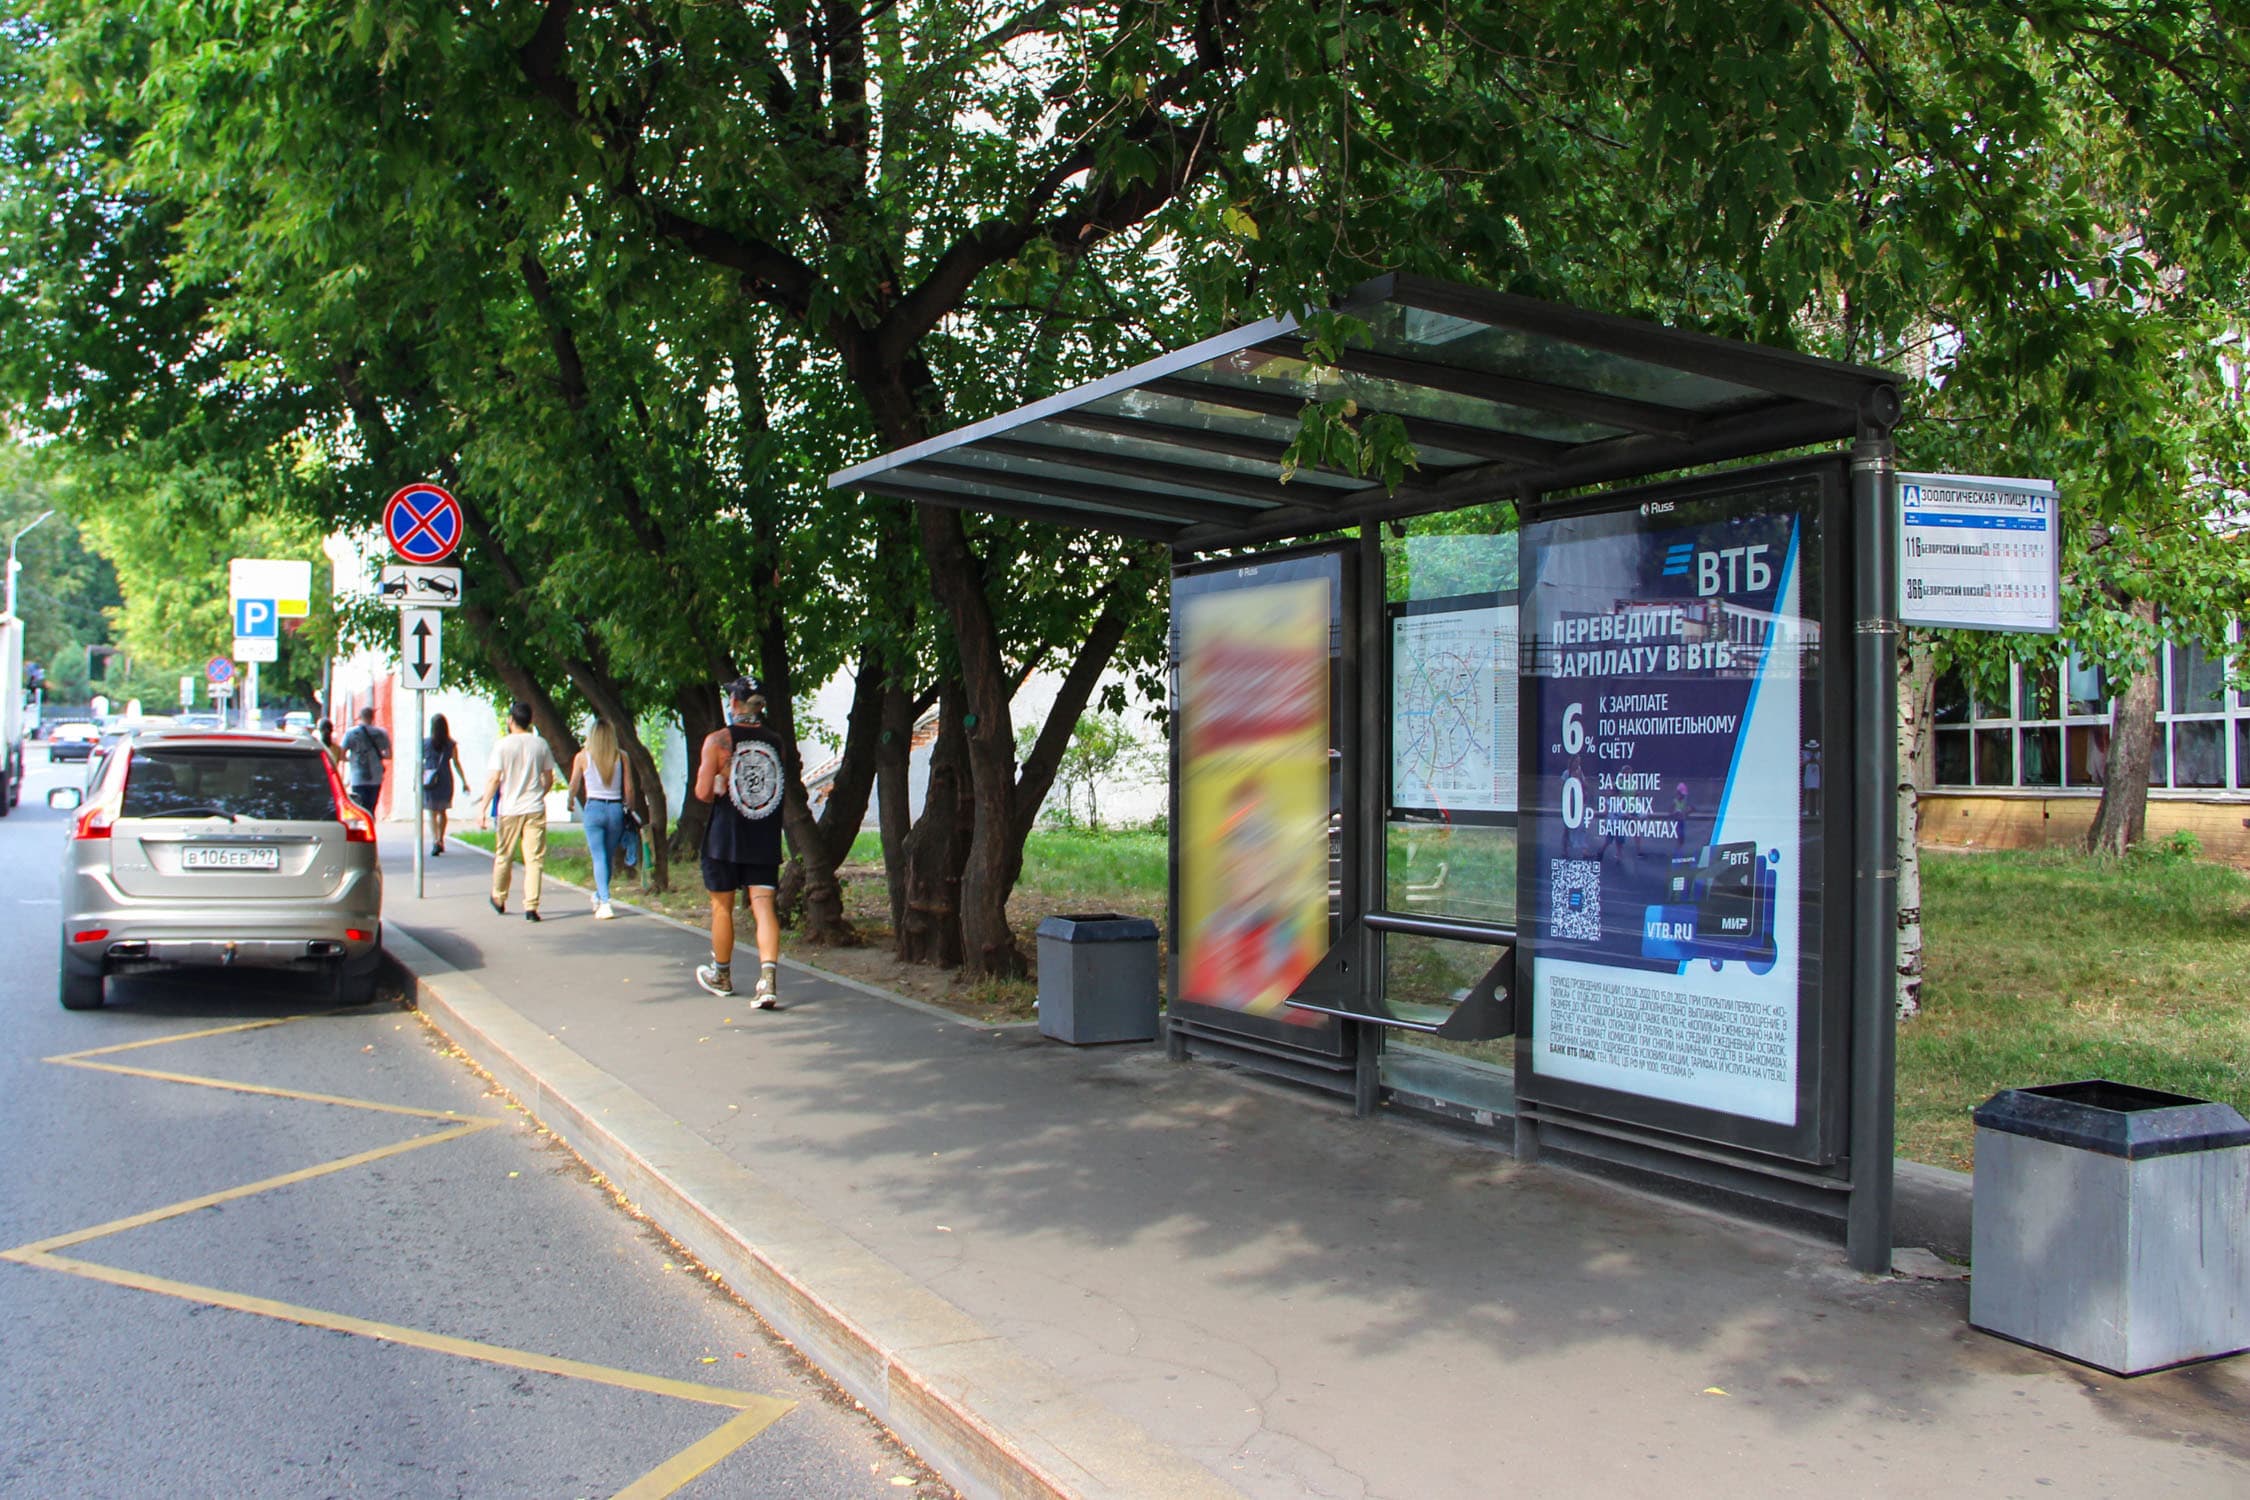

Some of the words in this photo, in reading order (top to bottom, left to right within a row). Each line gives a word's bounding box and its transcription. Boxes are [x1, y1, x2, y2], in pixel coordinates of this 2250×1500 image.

[1650, 501, 1674, 514] Russ
[1921, 489, 1996, 504] ЗООЛОГИЧЕСКАЯ
[1998, 493, 2027, 507] УЛИЦА
[1906, 537, 1921, 558] 116
[1697, 544, 1772, 597] ВТБ
[1907, 578, 1923, 599] 366
[244, 602, 268, 634] P
[1552, 608, 1684, 646] ПЕРЕВЕДИТЕ
[1552, 646, 1660, 679] ЗАРПЛАТУ
[1666, 645, 1680, 672] В
[1687, 641, 1737, 671] ВТБ:
[1600, 696, 1607, 712] К
[1610, 694, 1668, 712] ЗАРПЛАТЕ
[1600, 718, 1616, 735] ПО
[1619, 715, 1736, 734] НАКОПИТЕЛЬНОМУ
[1599, 738, 1635, 760] СЧЁТУ
[1599, 773, 1612, 790] ЗА
[1616, 772, 1660, 790] СНЯТИЕ
[1599, 796, 1606, 812] В
[1609, 796, 1653, 814] ЛЮБЫХ
[1599, 820, 1678, 838] БАНКОМАТАХ
[1730, 852, 1749, 865] ВТБ
[1647, 921, 1692, 940] VTB.RU
[1722, 918, 1748, 930] МИР
[1689, 994, 1702, 1006] ПРИ
[1702, 996, 1733, 1010] ОТКРЫТИИ
[1735, 1000, 1761, 1014] ПЕРВОГО
[1640, 1000, 1686, 1017] ДОПОЛНИТЕЛЬНО
[1688, 1006, 1737, 1024] ВЫПЛАЧИВАЕТСЯ
[1740, 1014, 1780, 1030] ПООЩРЕНИЕ
[1641, 1011, 1660, 1024] СТАВКЕ
[1722, 1023, 1762, 1039] ЕЖЕМЕСЯЧНО
[1764, 1029, 1773, 1041] НА
[1550, 1043, 1565, 1056] БАНК
[1567, 1046, 1577, 1058] ВТБ
[1686, 1030, 1711, 1045] СРЕДНИЙ
[1714, 1034, 1754, 1051] ЕЖЕДНЕВНЫЙ
[1639, 1035, 1650, 1047] ПРИ
[1676, 1040, 1708, 1056] НАЛИЧНЫХ
[1710, 1045, 1736, 1061] СРЕДСТВ
[1745, 1051, 1787, 1069] БАНКОМАТАХ
[1690, 1055, 1717, 1070] ТАРИФАХ
[1723, 1061, 1751, 1076] УСЛУГАХ
